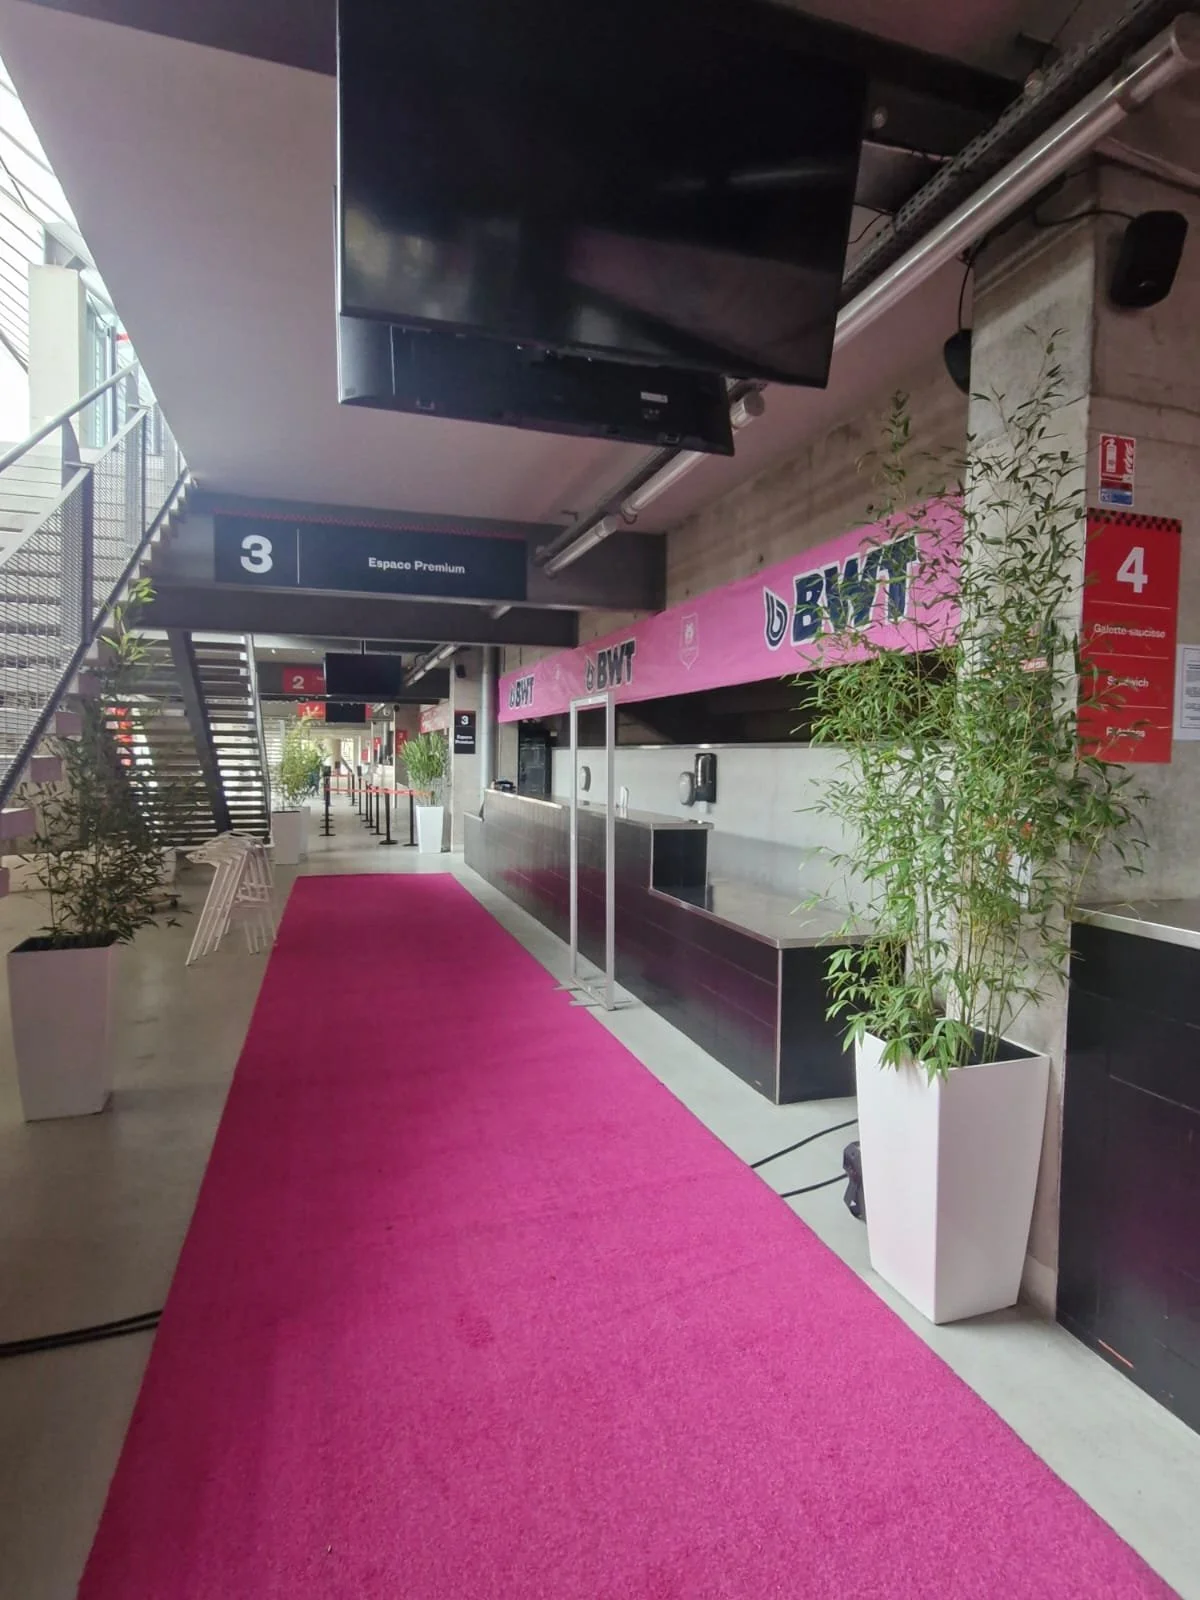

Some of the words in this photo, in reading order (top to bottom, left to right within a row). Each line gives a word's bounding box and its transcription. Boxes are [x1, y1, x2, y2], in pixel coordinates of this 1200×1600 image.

[240, 534, 273, 573] 3
[368, 557, 412, 571] Espace
[414, 560, 466, 574] Premium
[1116, 546, 1148, 593] 4
[791, 533, 921, 646] BWT
[292, 676, 305, 689] 2
[596, 638, 636, 691] BWT
[515, 674, 535, 709] BWT
[461, 715, 469, 725] 3
